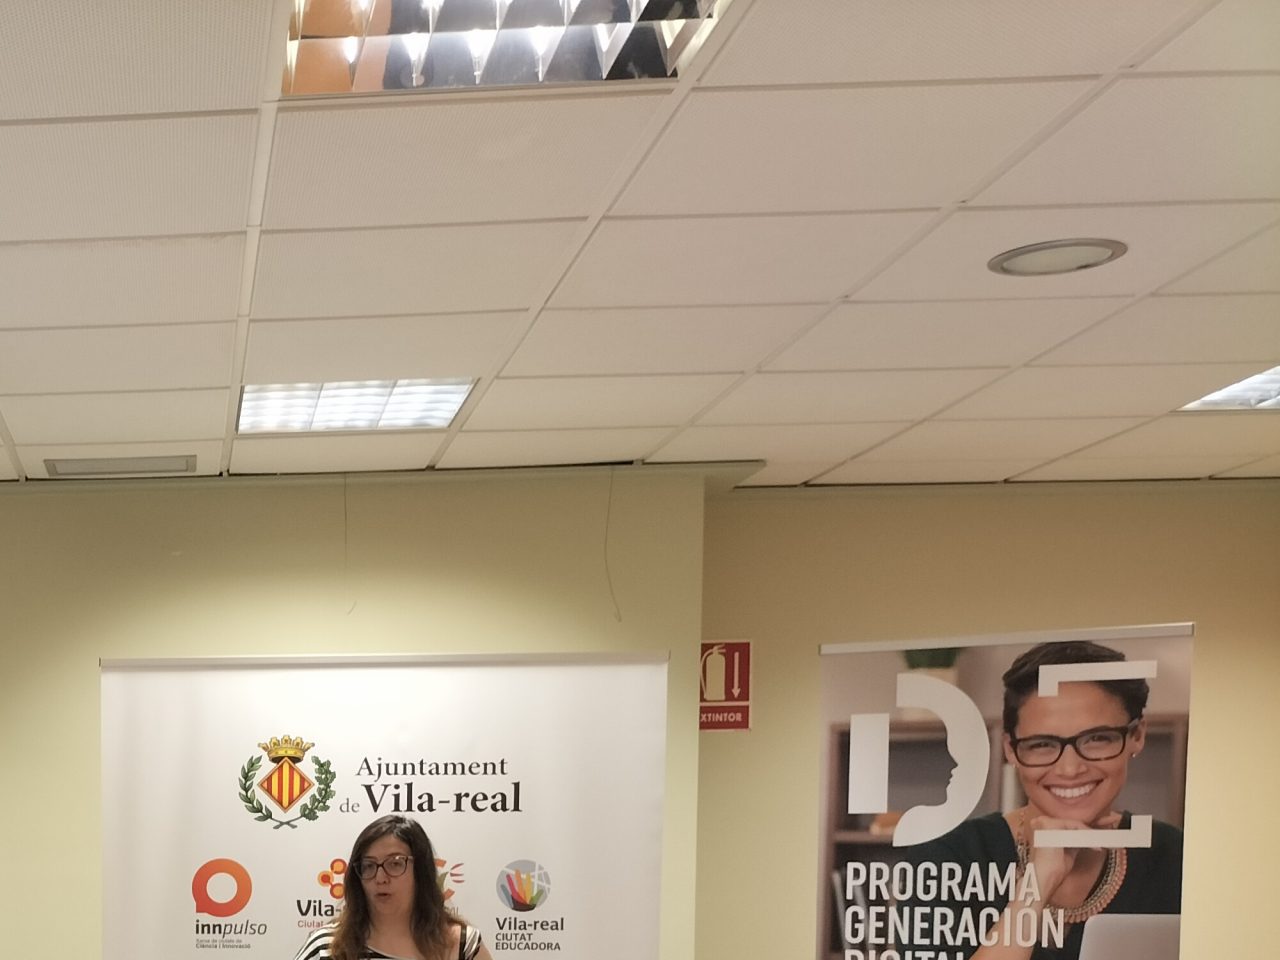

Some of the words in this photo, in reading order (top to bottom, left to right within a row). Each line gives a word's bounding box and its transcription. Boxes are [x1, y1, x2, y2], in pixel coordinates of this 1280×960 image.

[700, 712, 742, 722] XTINTOR
[355, 756, 508, 783] Ajuntament
[339, 797, 361, 814] de
[361, 781, 523, 813] Vila-real
[845, 861, 1041, 902] PROGRAMA
[296, 899, 342, 917] Vila-
[195, 919, 268, 939] innpulso
[495, 917, 565, 931] Vila-real
[844, 898, 1065, 949] GENERACIÓN
[495, 932, 533, 942] CIUTAT
[495, 942, 561, 951] EDUCADORA
